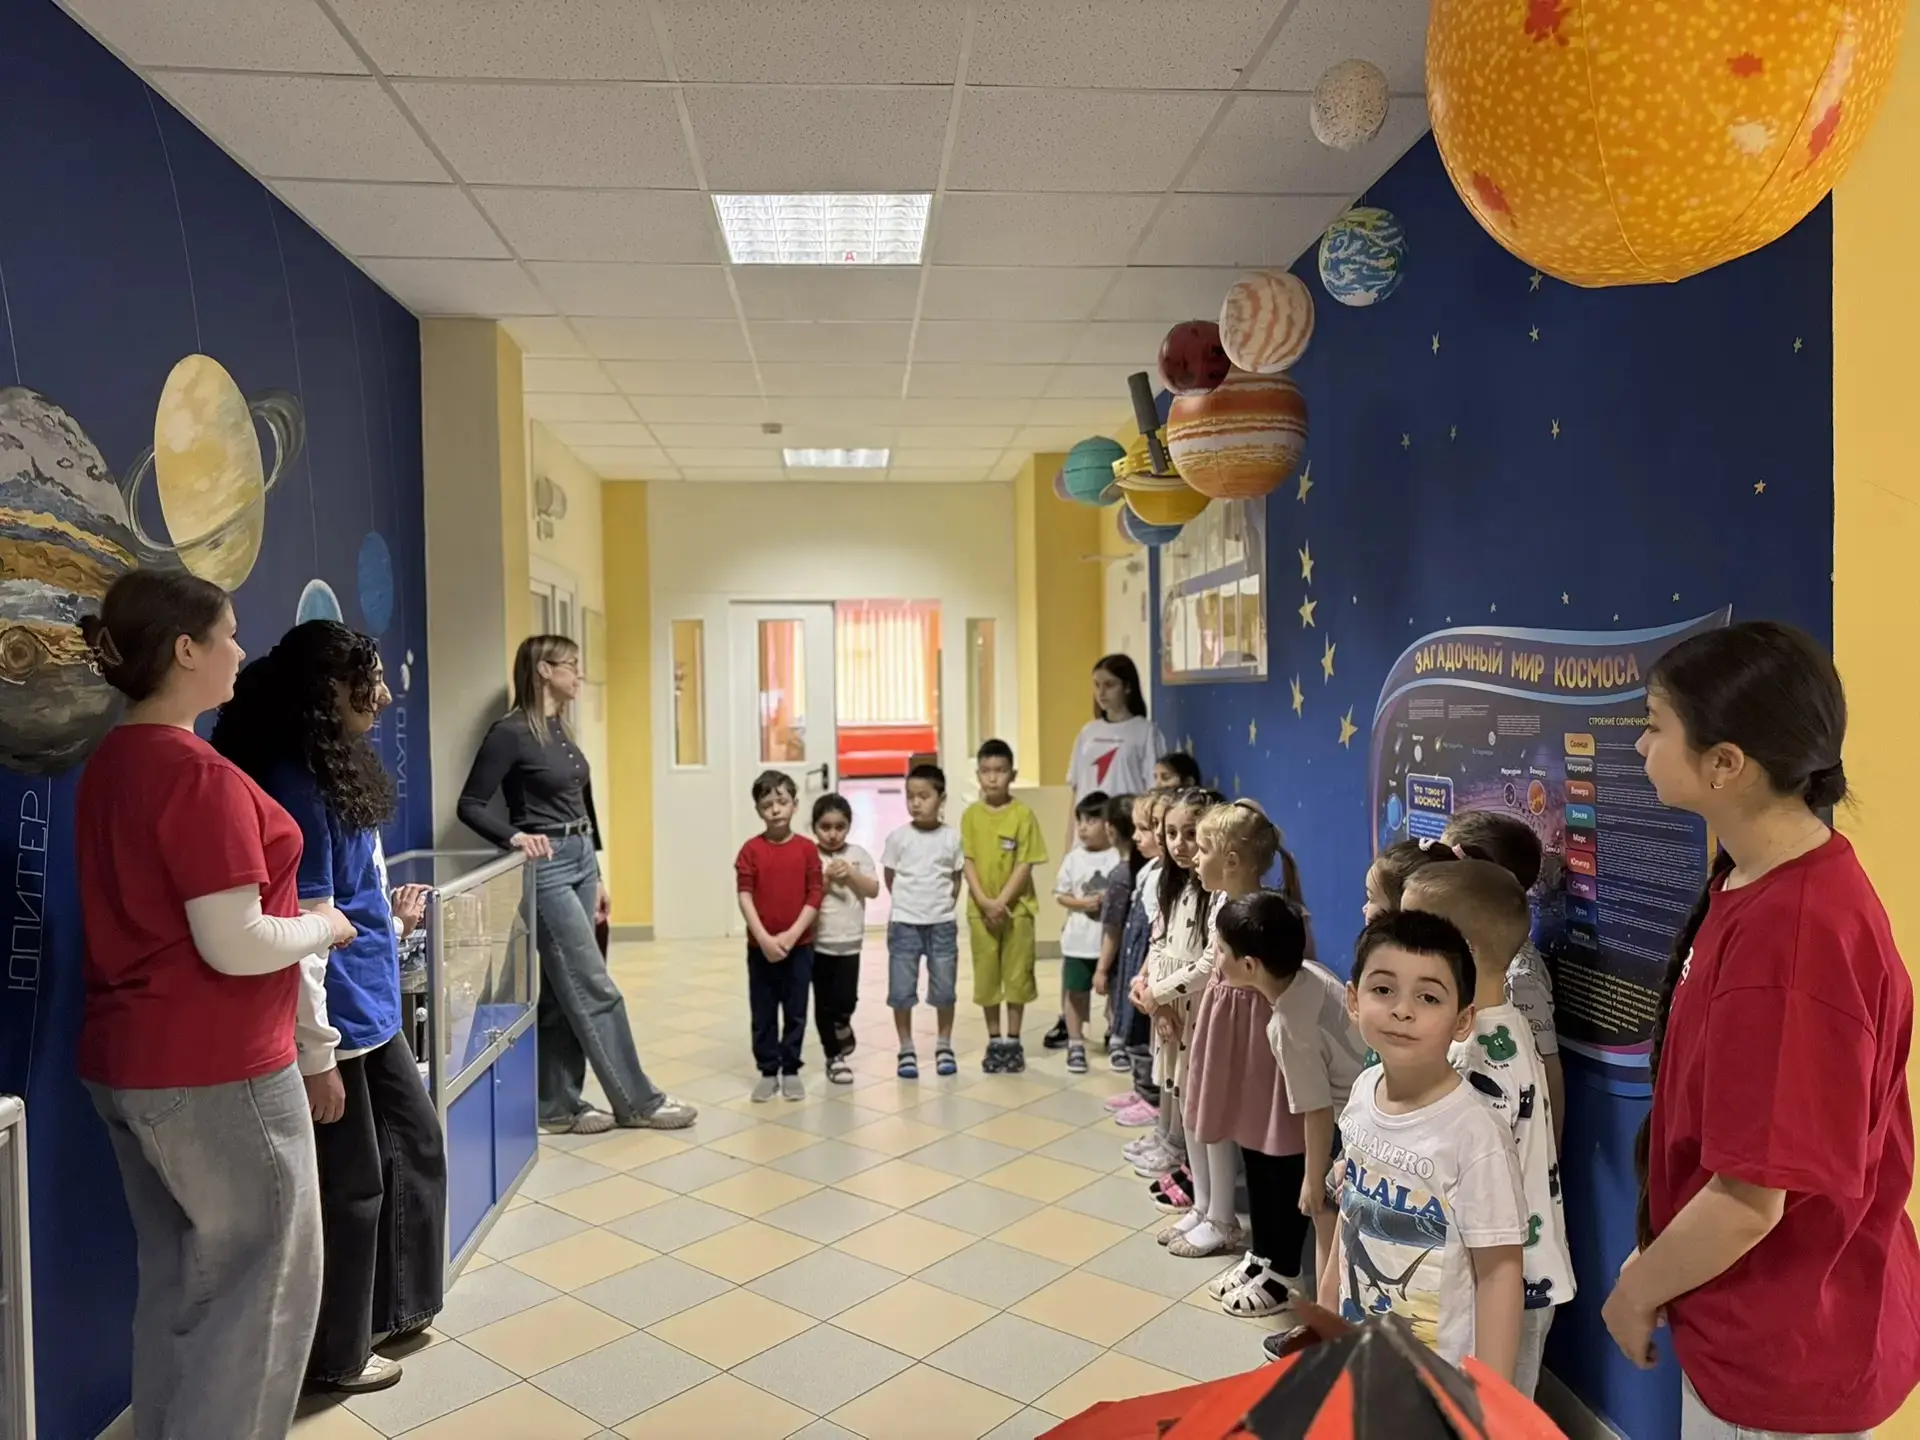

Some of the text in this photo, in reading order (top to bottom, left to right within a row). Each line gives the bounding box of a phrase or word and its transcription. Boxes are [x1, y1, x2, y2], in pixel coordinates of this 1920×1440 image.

[1414, 641, 1640, 689] ЗАГАДОЧНЫЙ МИР КОСМОСА
[1588, 716, 1616, 726] СТРОЕНИЕ
[1570, 740, 1589, 749] Солнце
[1567, 763, 1593, 774] Меркурий
[1571, 786, 1589, 797] Венера
[1572, 809, 1588, 820] Земля
[1572, 833, 1587, 845] Марс
[7, 790, 48, 991] ЮПИТЕР
